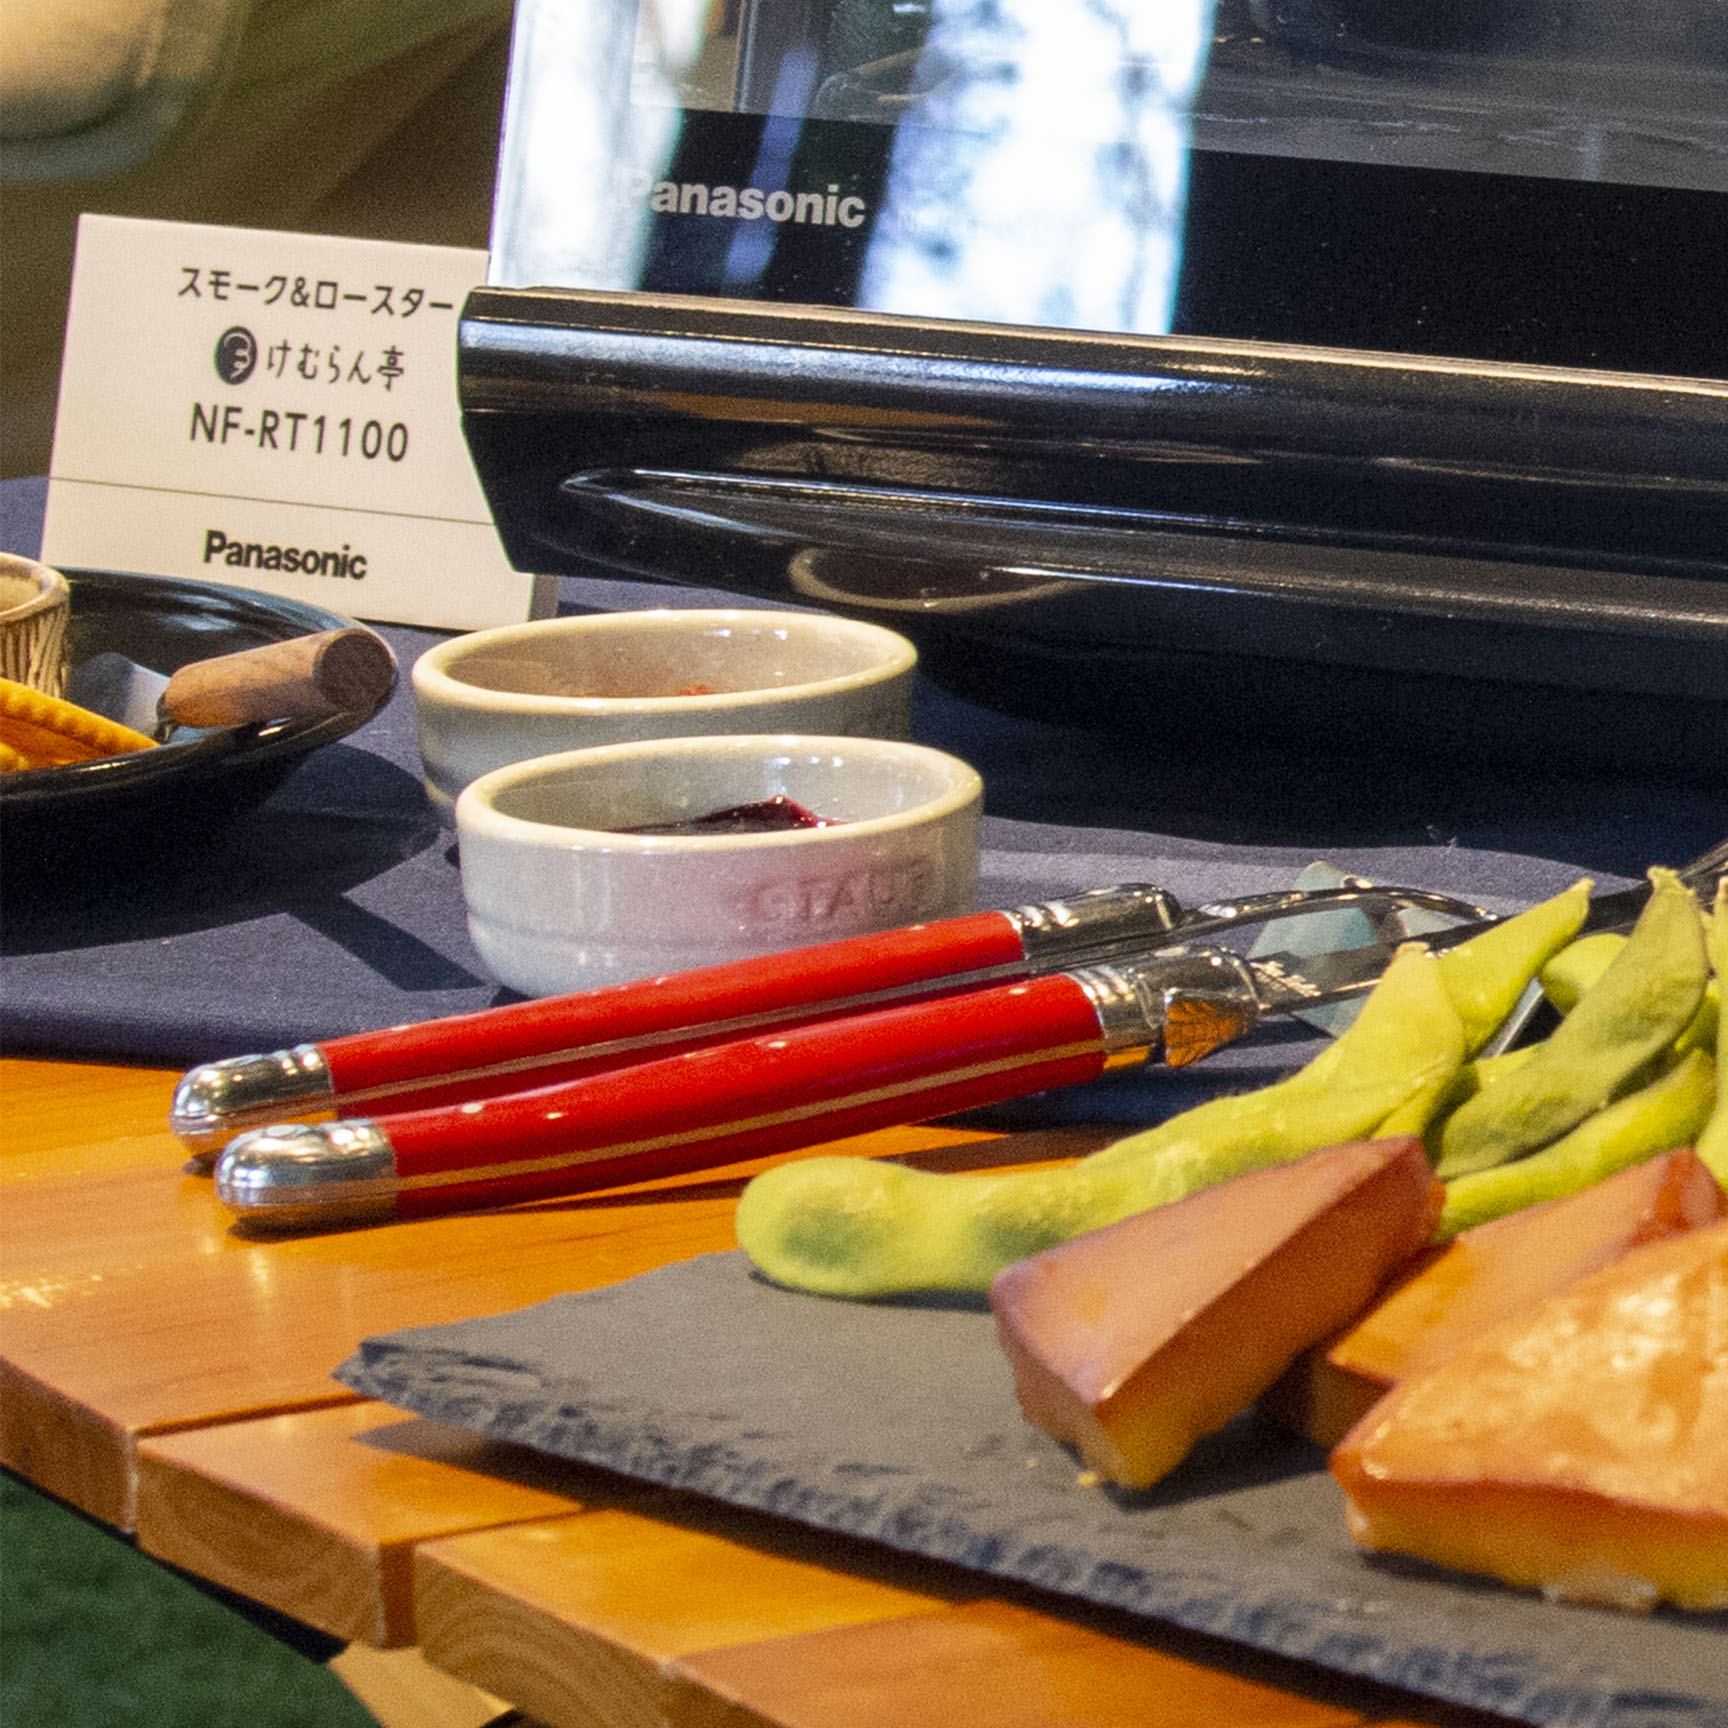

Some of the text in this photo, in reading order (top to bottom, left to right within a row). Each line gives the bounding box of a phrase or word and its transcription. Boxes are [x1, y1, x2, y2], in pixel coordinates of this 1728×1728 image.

[618, 165, 866, 228] anasonic
[177, 266, 454, 319] スモーク&ロースター
[267, 338, 405, 392] けむらん亭
[189, 401, 409, 463] NF-RT1100
[203, 529, 368, 581] Panasonic
